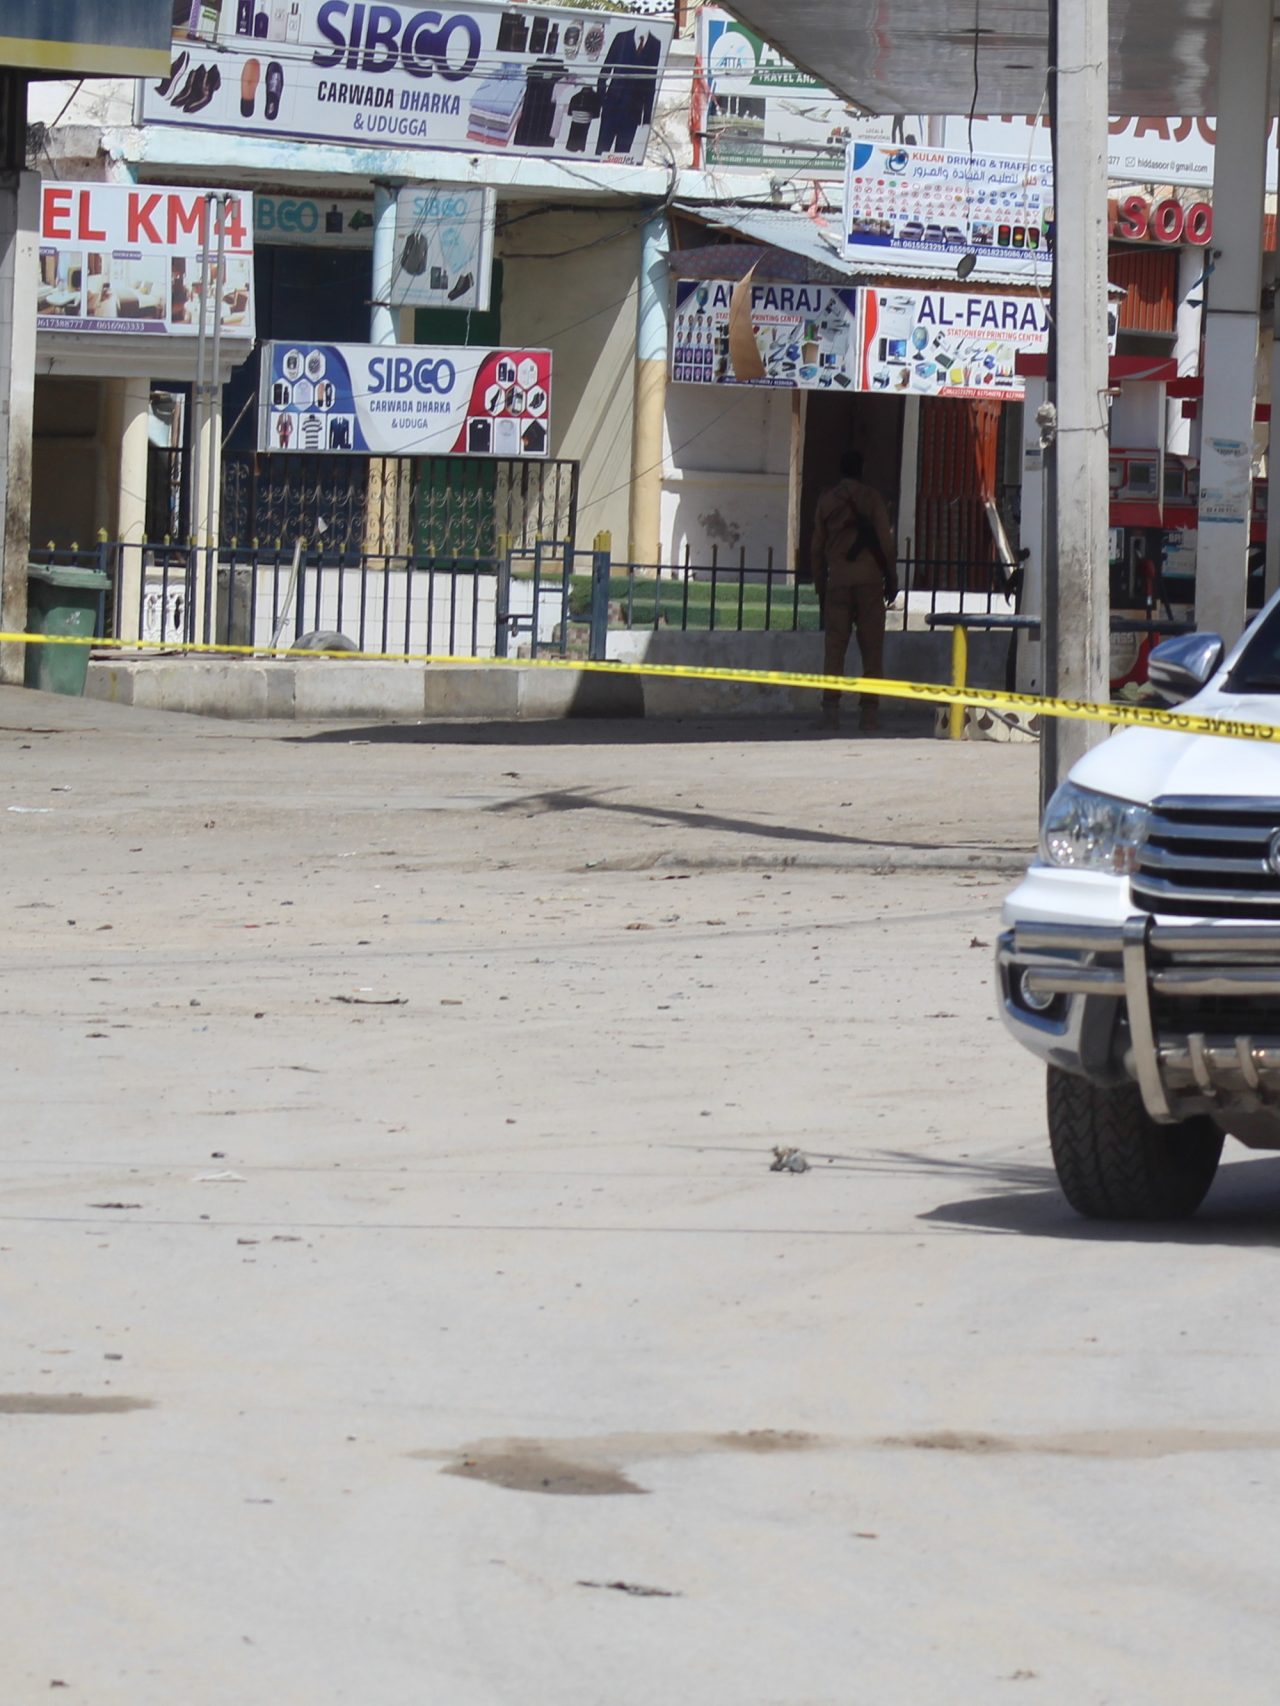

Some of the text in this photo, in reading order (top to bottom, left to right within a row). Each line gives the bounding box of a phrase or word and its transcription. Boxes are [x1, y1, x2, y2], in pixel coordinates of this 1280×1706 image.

[312, 0, 481, 82] SIBCO
[758, 70, 794, 84] TRAVEL
[317, 80, 460, 116] CARWADA DHARKA
[353, 113, 427, 137] & UDUGGA
[911, 151, 945, 163] KULAN
[946, 155, 986, 168] DRIVING
[989, 159, 998, 169] &
[999, 160, 1036, 172] TRAFFIC
[127, 192, 247, 248] KM4
[1114, 195, 1214, 246] SOO
[946, 327, 1043, 343] STATIONERY PRINTING CENTRE
[367, 356, 456, 395] SIBCO
[369, 400, 451, 414] CARWADA DHARKA
[391, 418, 428, 430] & UDUGA
